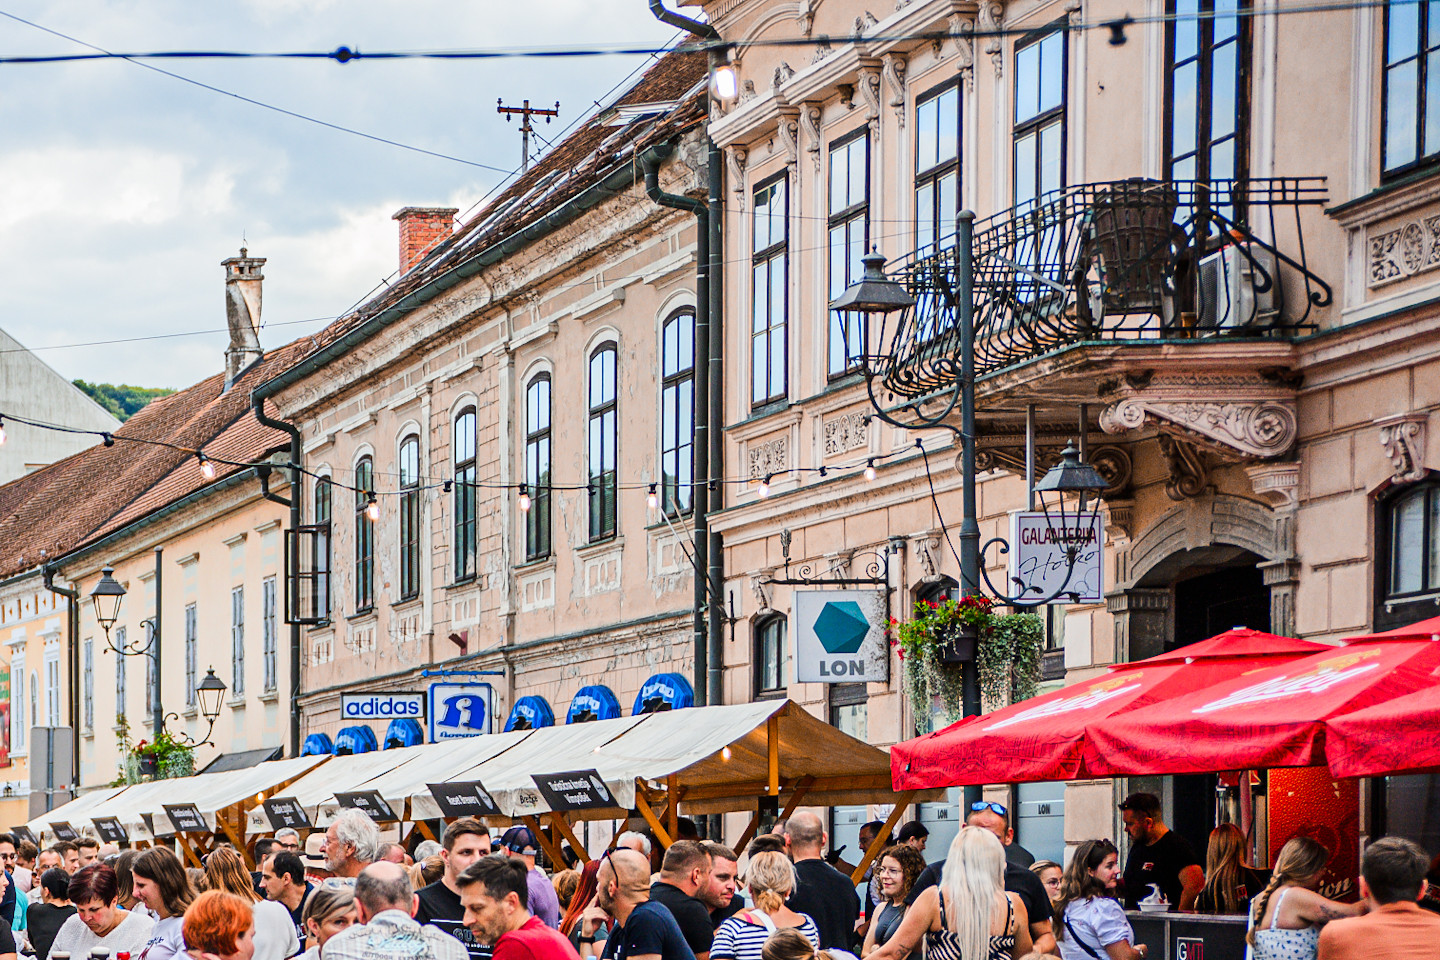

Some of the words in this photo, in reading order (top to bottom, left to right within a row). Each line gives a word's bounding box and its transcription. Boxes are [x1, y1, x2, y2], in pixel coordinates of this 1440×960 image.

[1022, 527, 1097, 547] GALANTERIJA
[819, 659, 865, 676] LON
[346, 697, 419, 716] adidas
[937, 809, 948, 819] LON
[1037, 804, 1051, 815] LON
